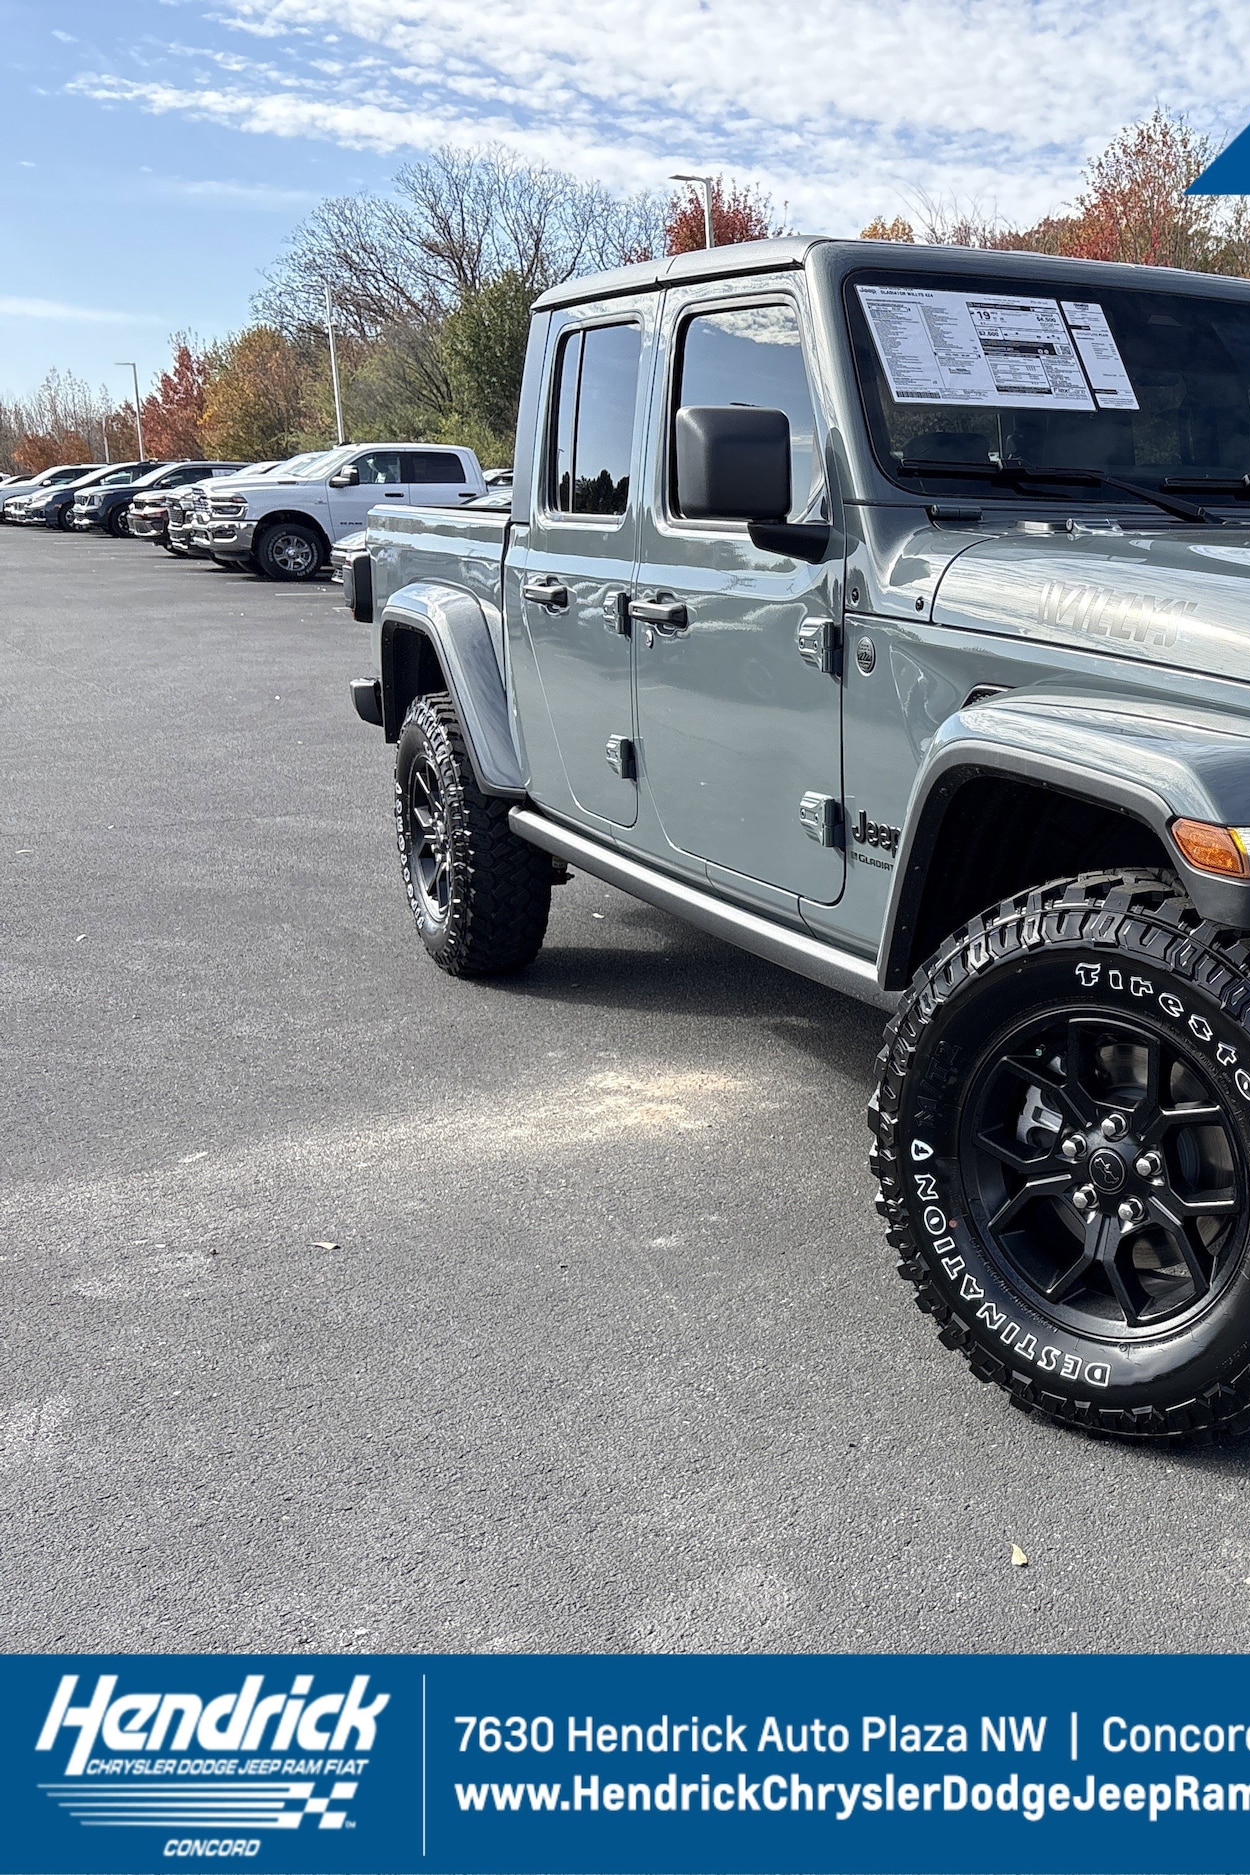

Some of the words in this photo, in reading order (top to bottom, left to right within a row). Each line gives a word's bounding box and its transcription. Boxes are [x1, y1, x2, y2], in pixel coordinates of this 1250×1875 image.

[976, 311, 991, 320] 19
[851, 809, 902, 858] Jeep
[858, 853, 895, 872] GLADIAT
[912, 1172, 1113, 1388] DESTINATION
